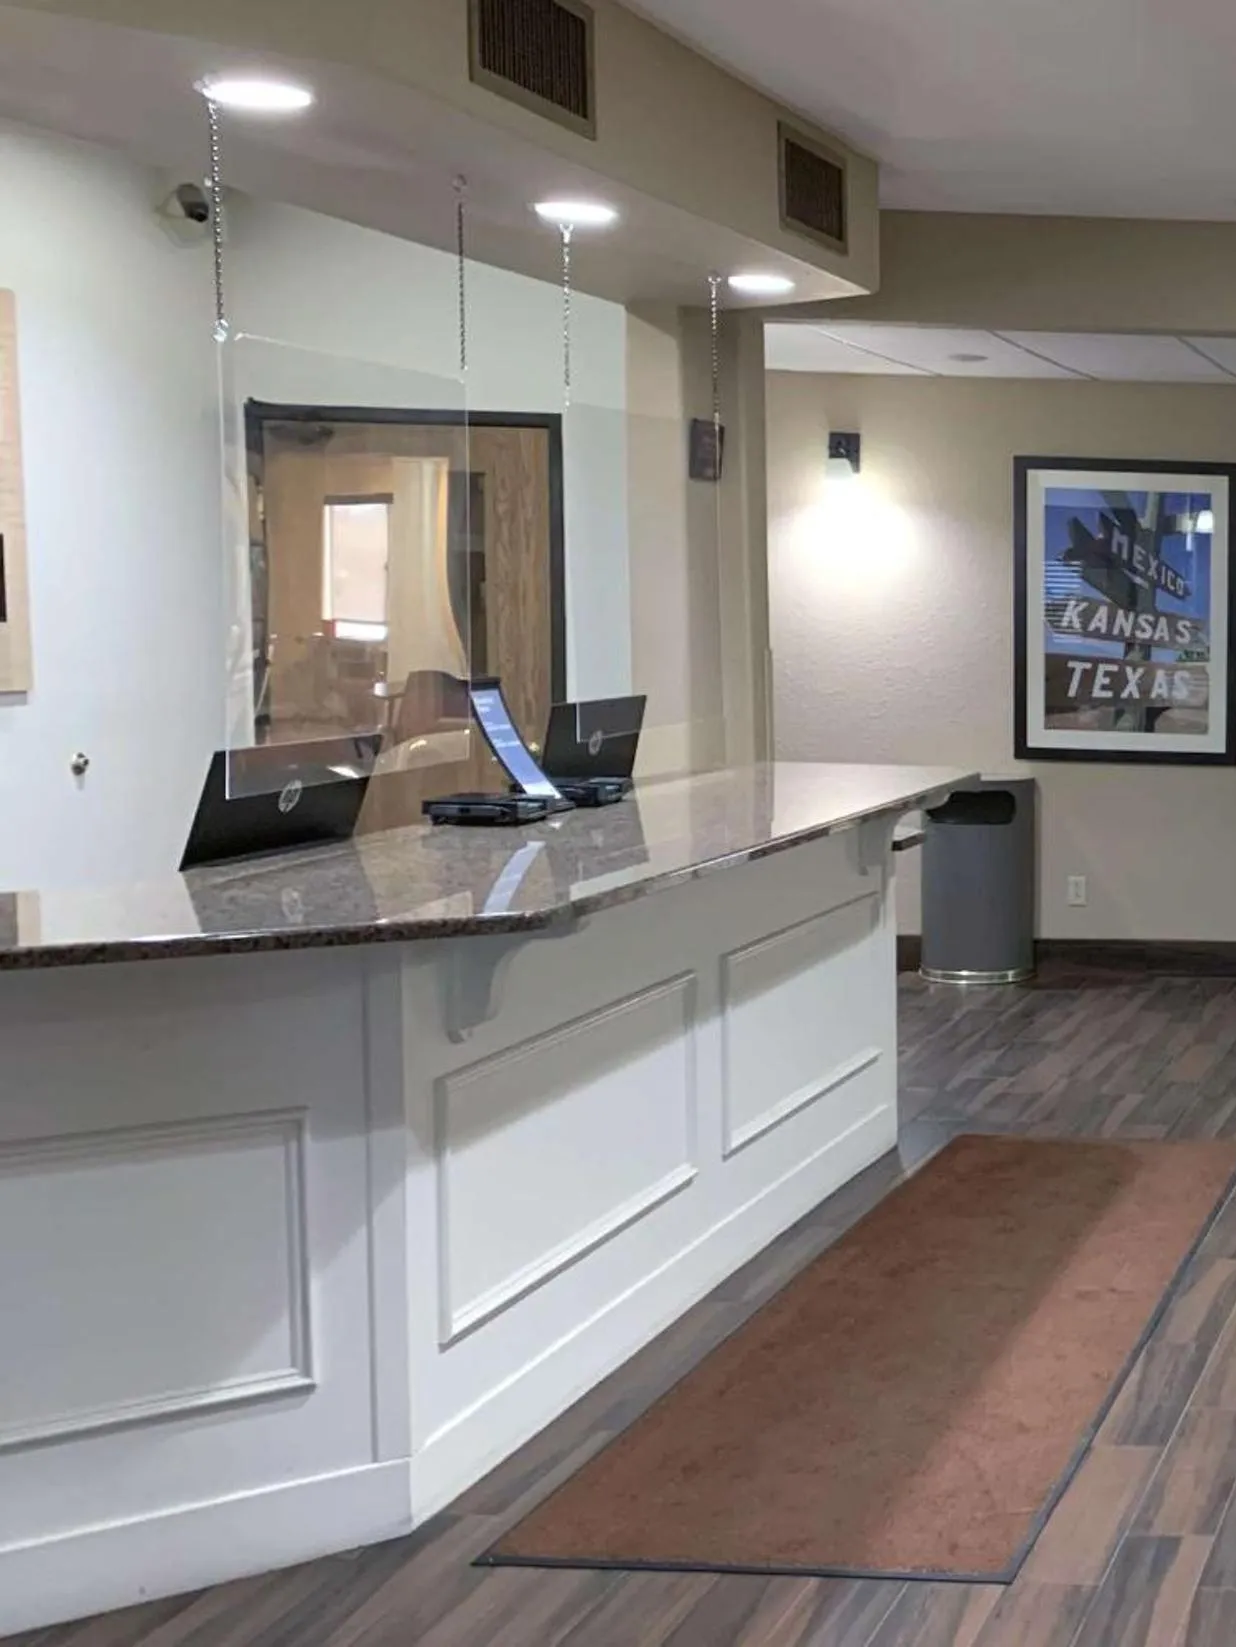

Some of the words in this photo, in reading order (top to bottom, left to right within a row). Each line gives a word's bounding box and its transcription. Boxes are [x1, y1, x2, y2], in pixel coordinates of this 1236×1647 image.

[1111, 528, 1186, 597] MEXICO
[1060, 599, 1192, 644] KANSAS
[1066, 661, 1192, 700] TEXAS
